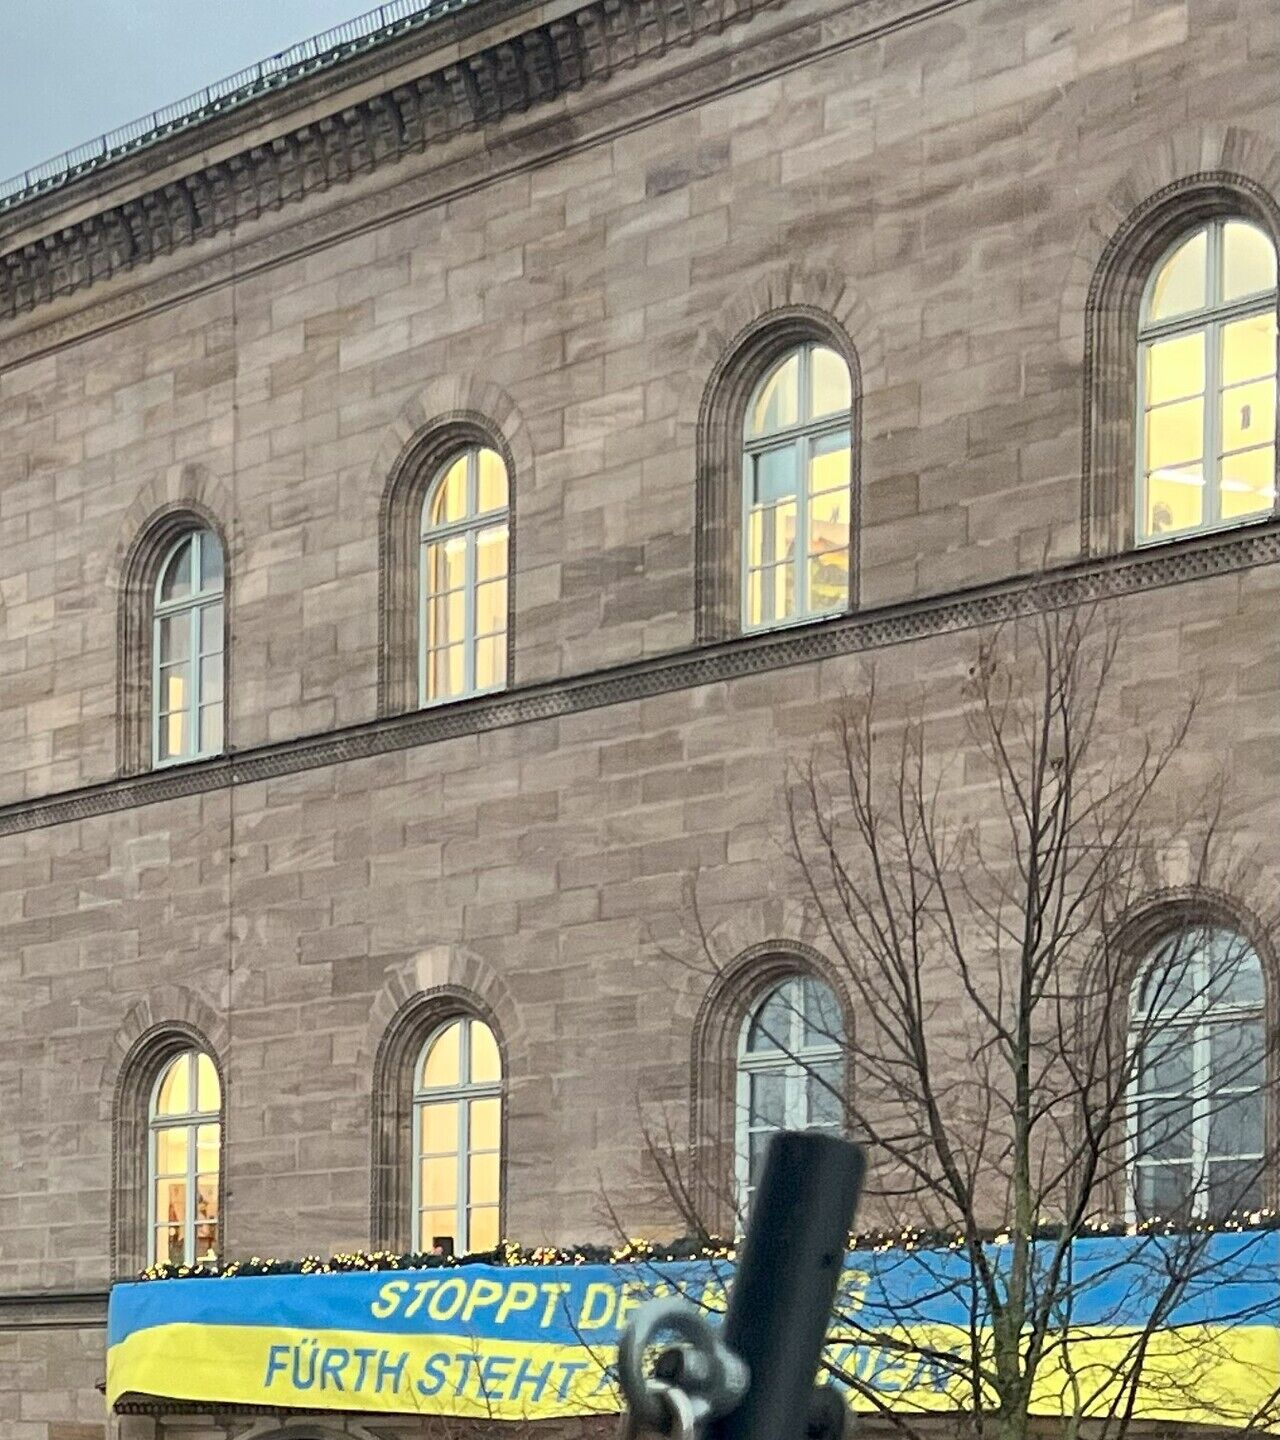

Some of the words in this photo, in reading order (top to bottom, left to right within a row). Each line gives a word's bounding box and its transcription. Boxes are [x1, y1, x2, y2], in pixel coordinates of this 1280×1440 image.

[371, 1278, 571, 1328] STOPPT
[264, 1337, 410, 1394] FÜRTH
[416, 1352, 589, 1403] STEHT
